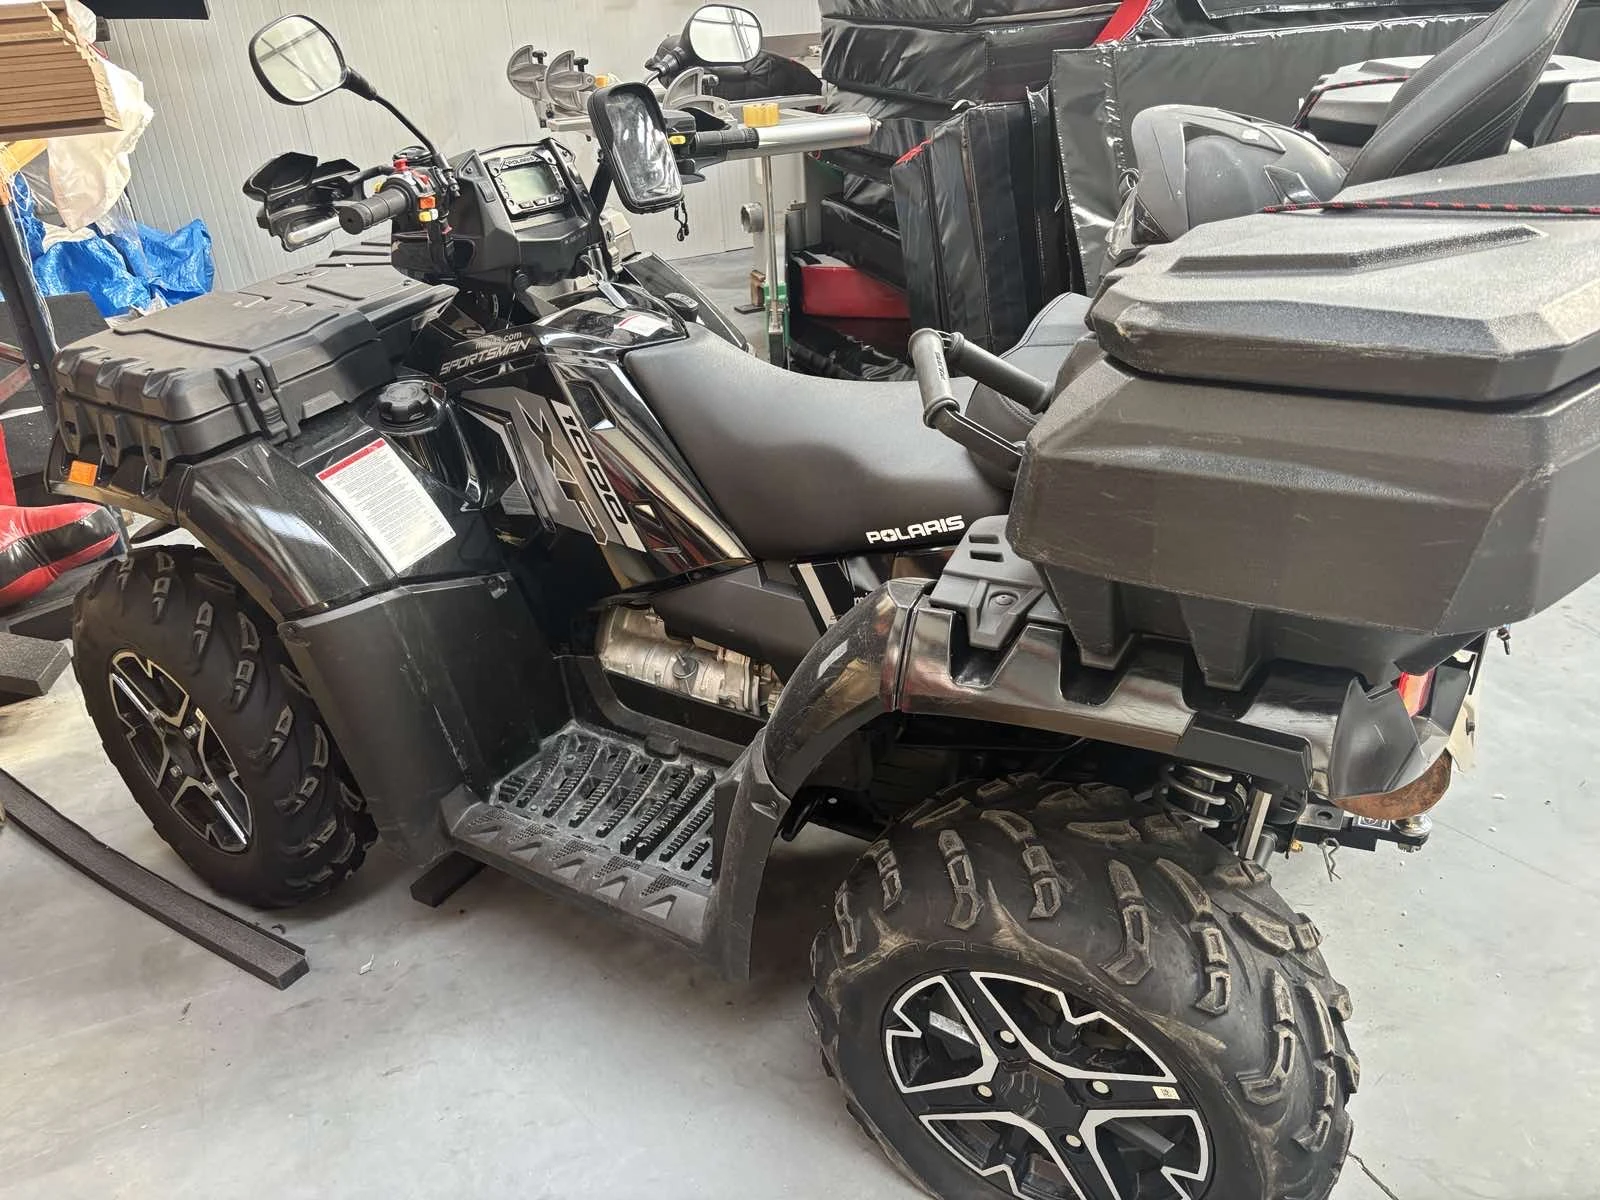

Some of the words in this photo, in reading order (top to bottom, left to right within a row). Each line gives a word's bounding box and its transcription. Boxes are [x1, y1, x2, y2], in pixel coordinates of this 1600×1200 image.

[439, 337, 532, 376] SPORTSMAN
[513, 395, 609, 546] XP
[560, 414, 631, 526] 1000
[865, 514, 966, 544] POLARIS
